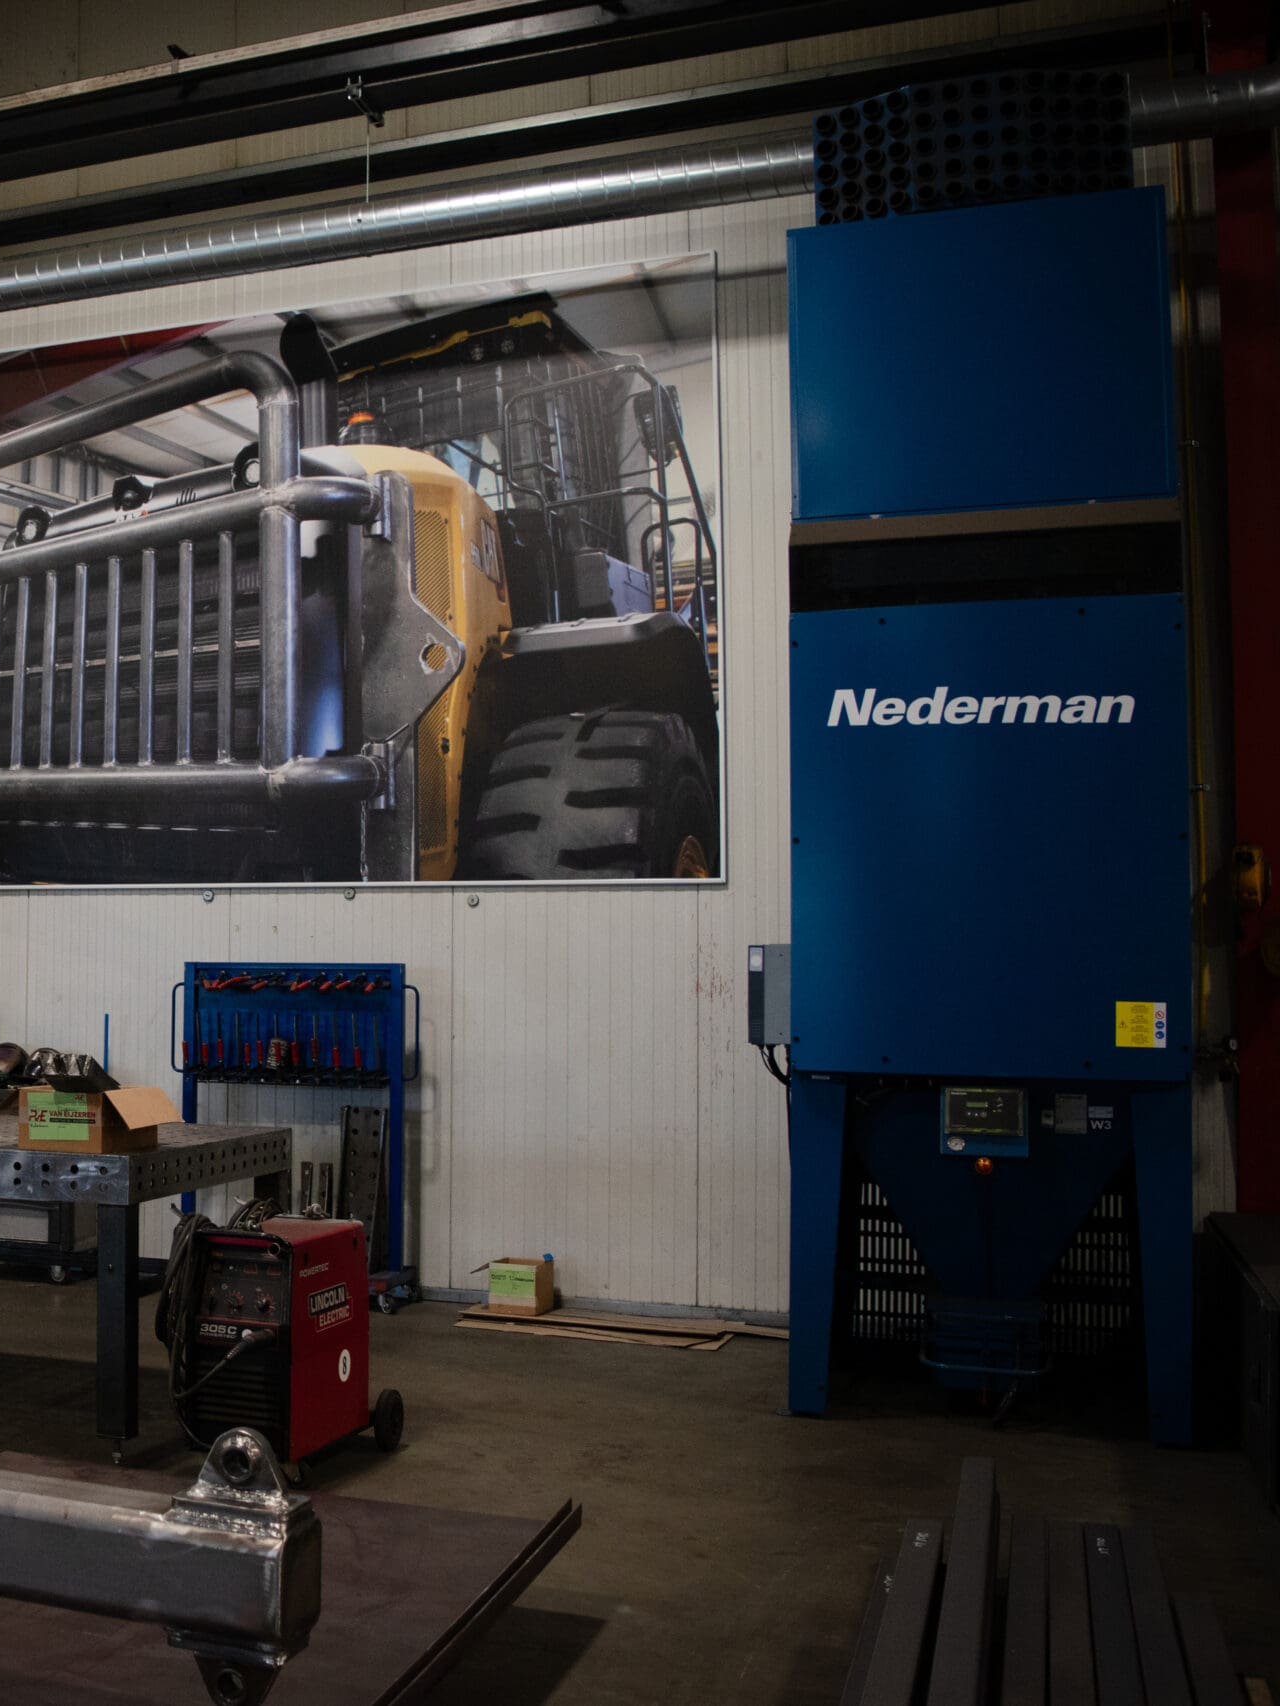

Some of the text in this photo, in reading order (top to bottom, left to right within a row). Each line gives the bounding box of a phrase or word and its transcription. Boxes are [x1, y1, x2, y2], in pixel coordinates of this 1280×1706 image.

[827, 686, 1136, 727] Nederman
[1090, 1119, 1112, 1131] W3
[310, 1286, 345, 1313] LINCOLN
[319, 1304, 350, 1327] ELECTRIC
